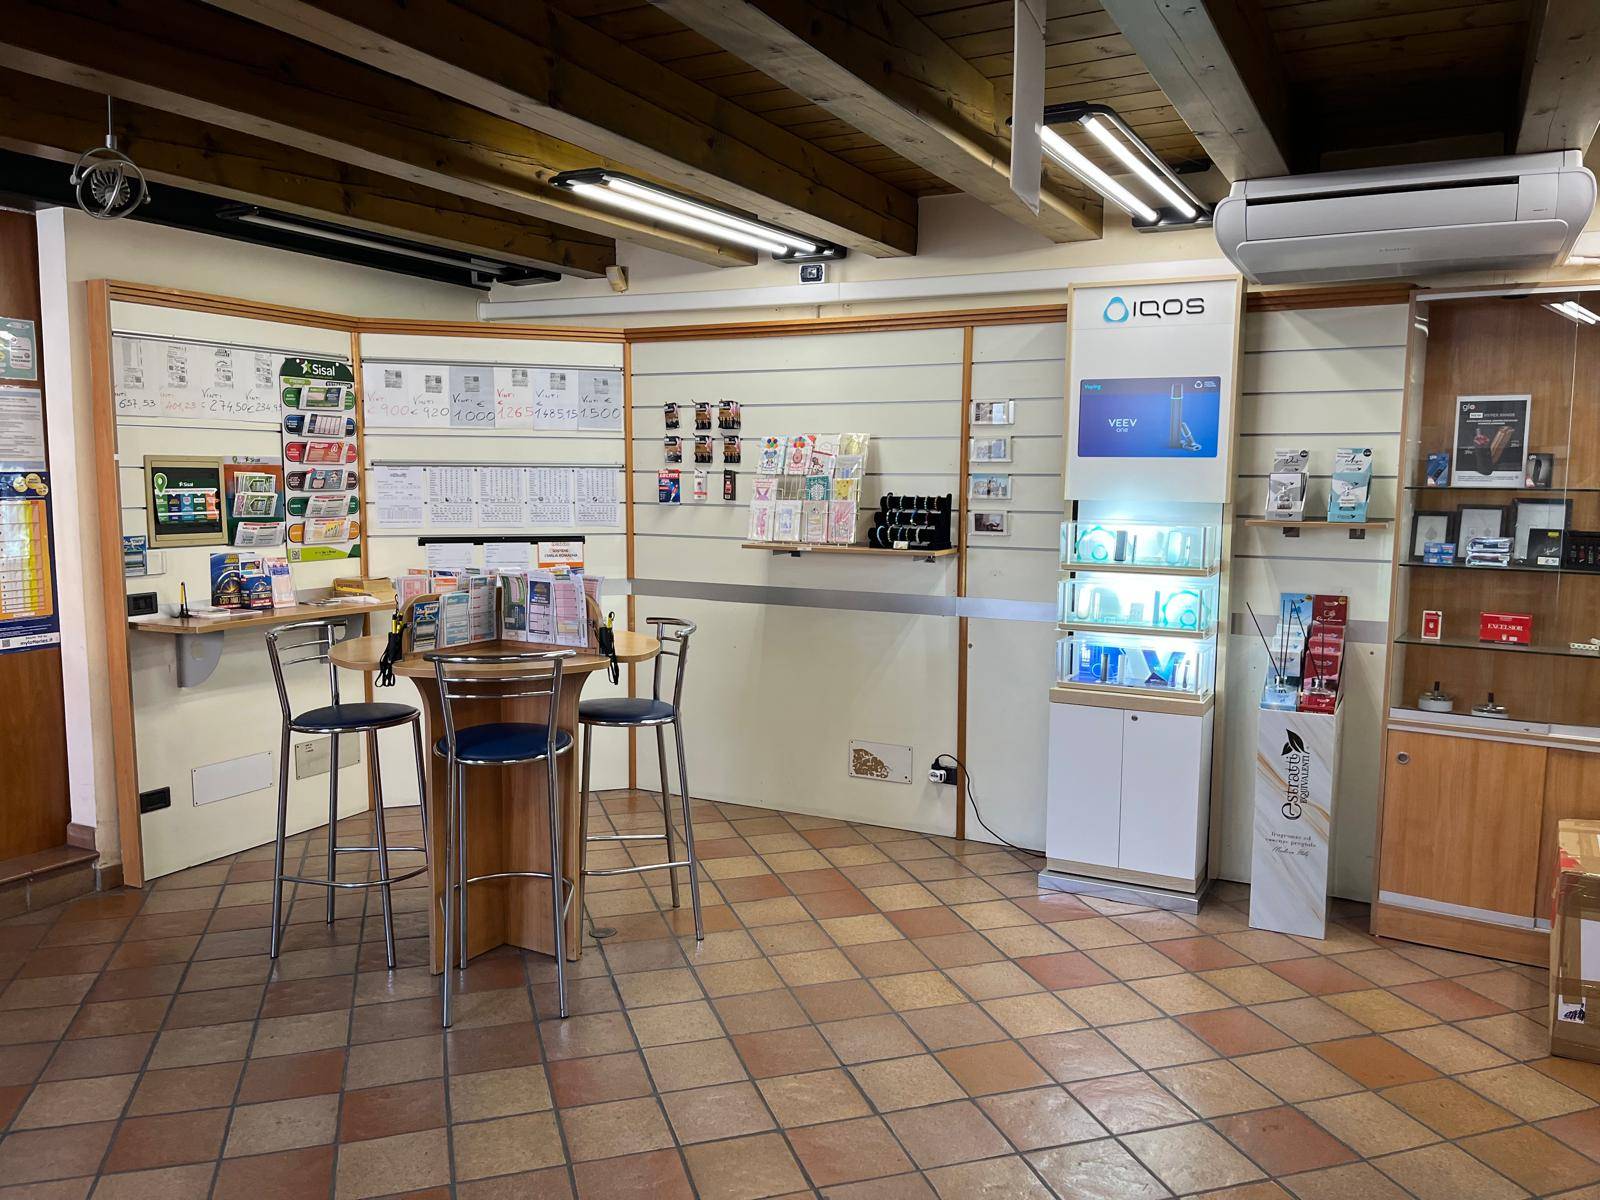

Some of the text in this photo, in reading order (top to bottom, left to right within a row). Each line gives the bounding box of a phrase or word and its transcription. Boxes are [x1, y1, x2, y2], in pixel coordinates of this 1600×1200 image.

[1133, 298, 1205, 318] IQOS
[312, 364, 336, 377] Sisal
[209, 400, 248, 414] 274,50
[424, 407, 450, 418] 920
[1108, 418, 1137, 427] VEEV
[1487, 623, 1523, 631] EXCELSIOR
[1300, 755, 1310, 804] EQUIVALENTI
